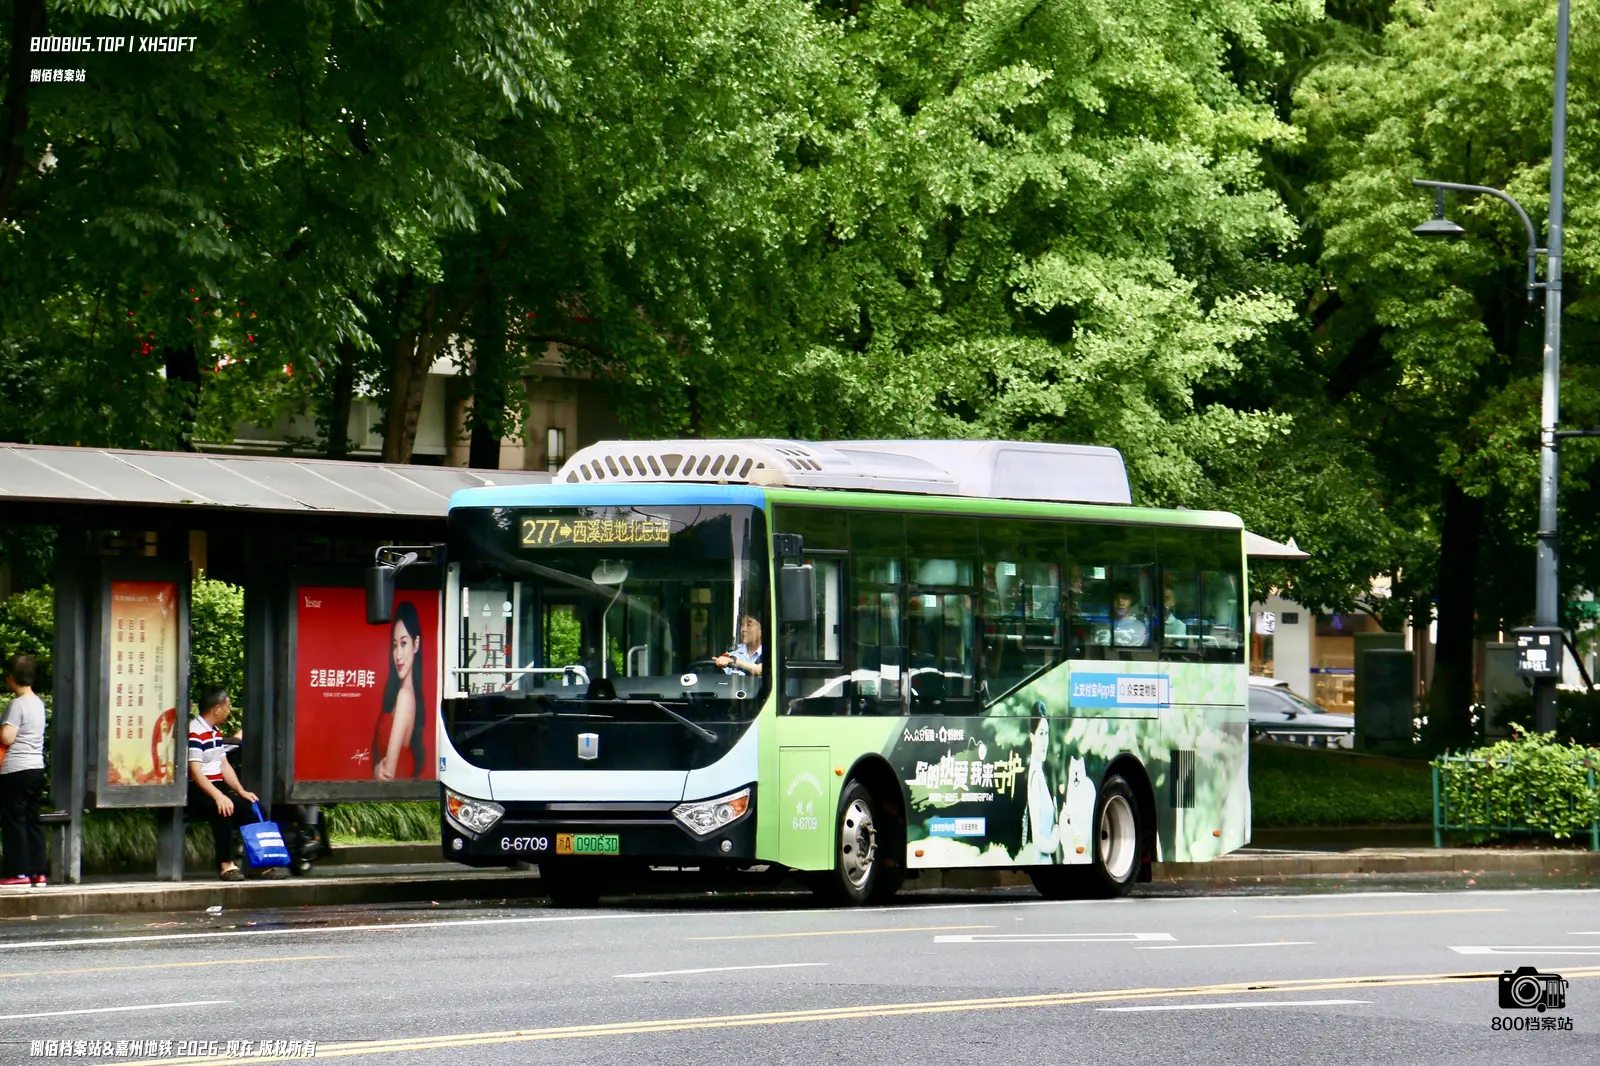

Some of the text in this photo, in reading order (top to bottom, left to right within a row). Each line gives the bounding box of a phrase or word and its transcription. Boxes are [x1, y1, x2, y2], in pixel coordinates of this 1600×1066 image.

[523, 519, 669, 544] 277 西溪湿地北总站
[310, 669, 375, 688] 艺星品牌21周年
[792, 816, 818, 830] 6-6709
[501, 837, 548, 850] 6-6709
